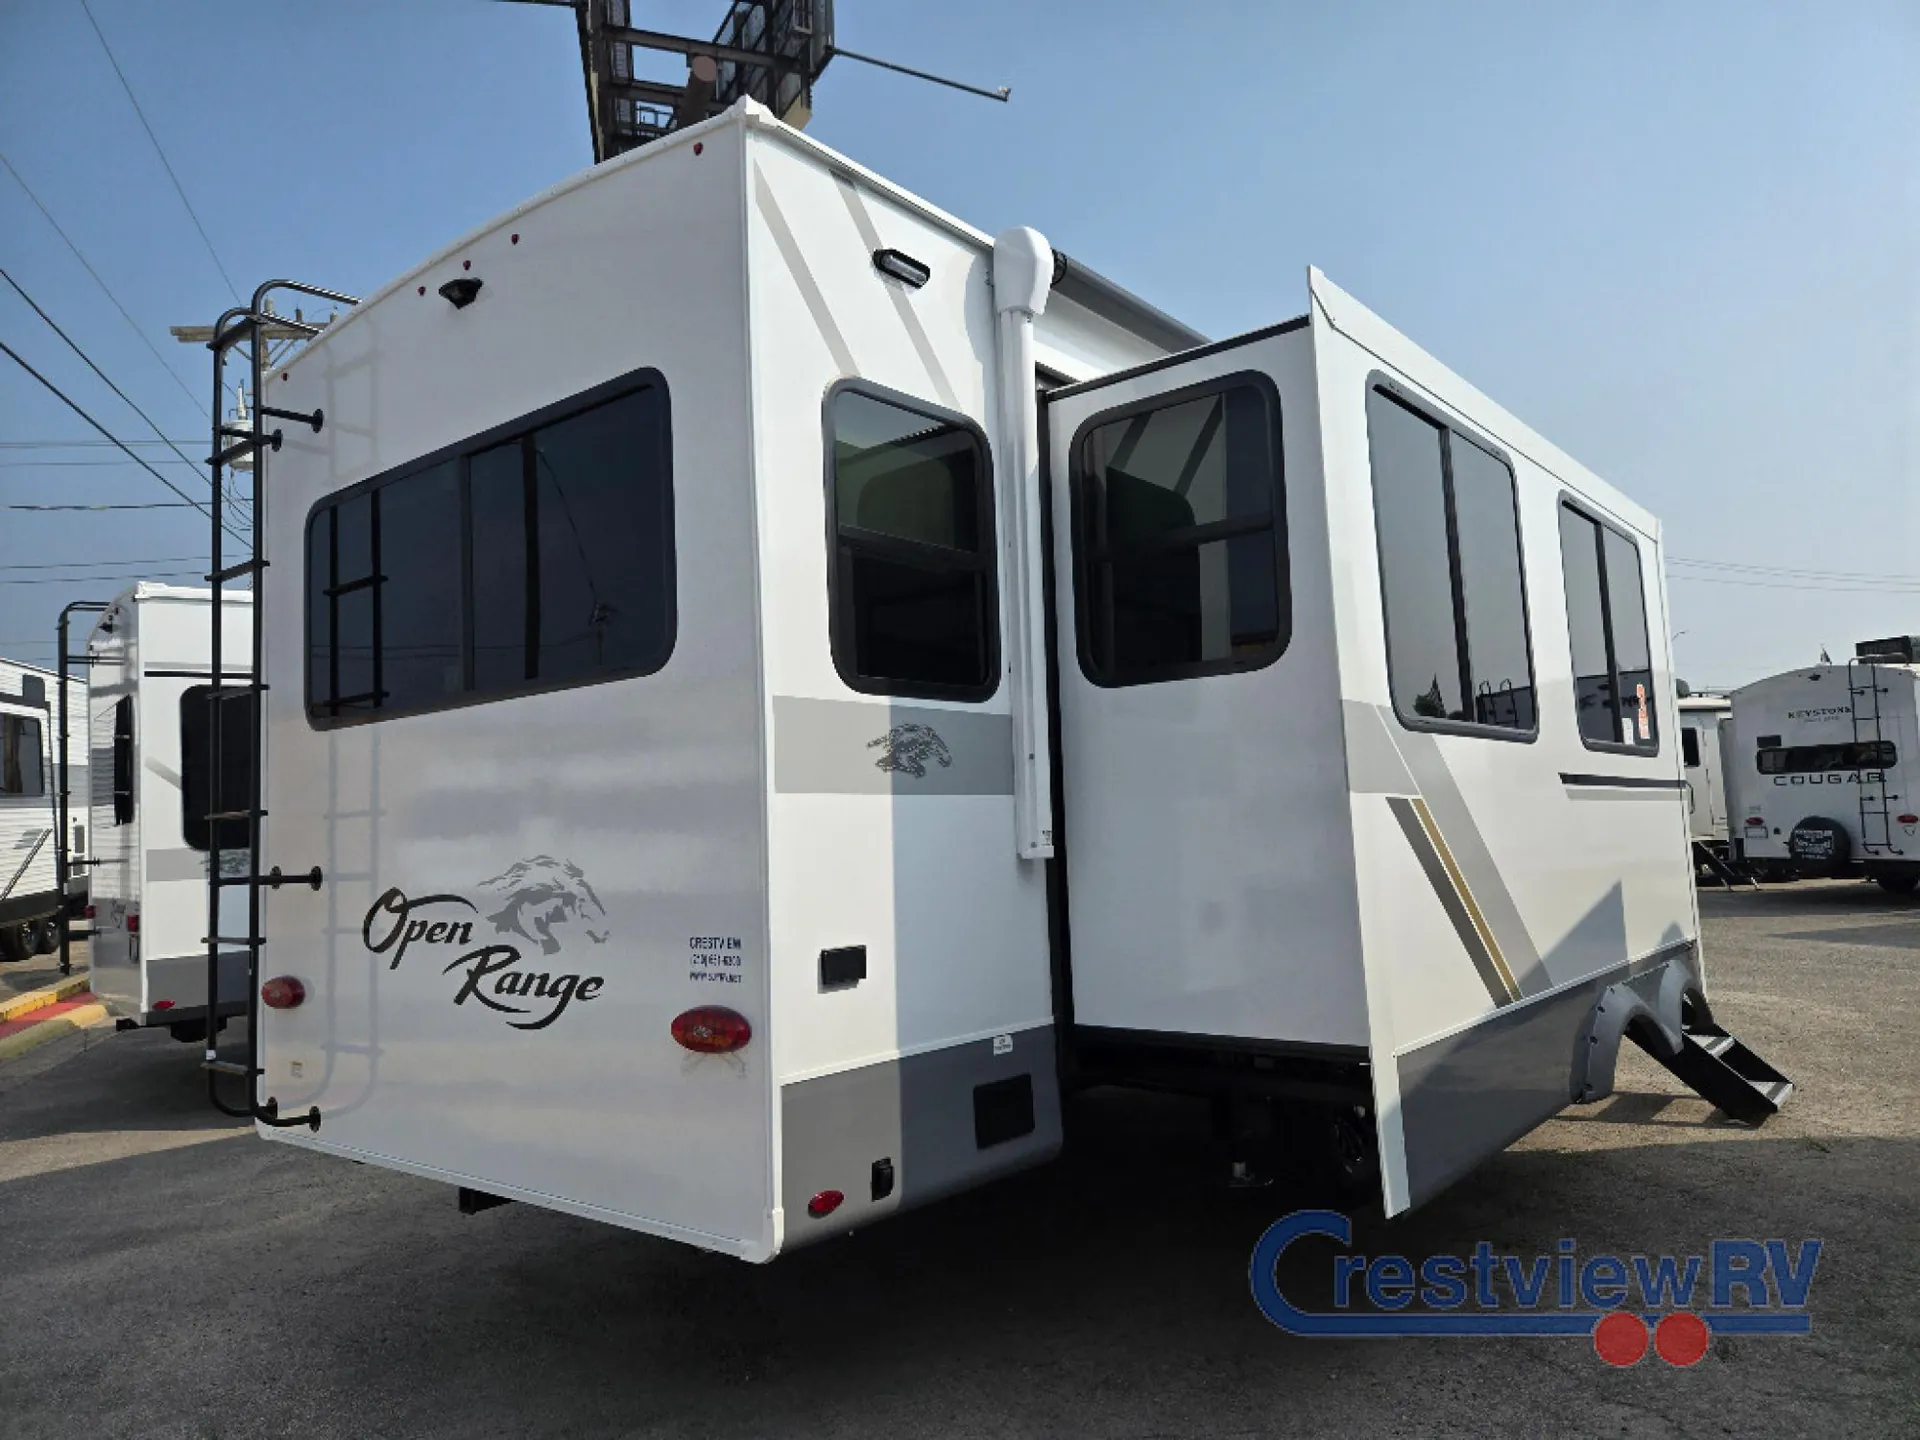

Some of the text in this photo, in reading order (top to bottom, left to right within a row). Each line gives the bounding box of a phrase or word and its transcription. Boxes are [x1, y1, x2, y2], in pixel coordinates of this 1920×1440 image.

[363, 887, 479, 970] Open
[689, 936, 742, 949] CRESTVEW
[442, 944, 605, 1030] Range
